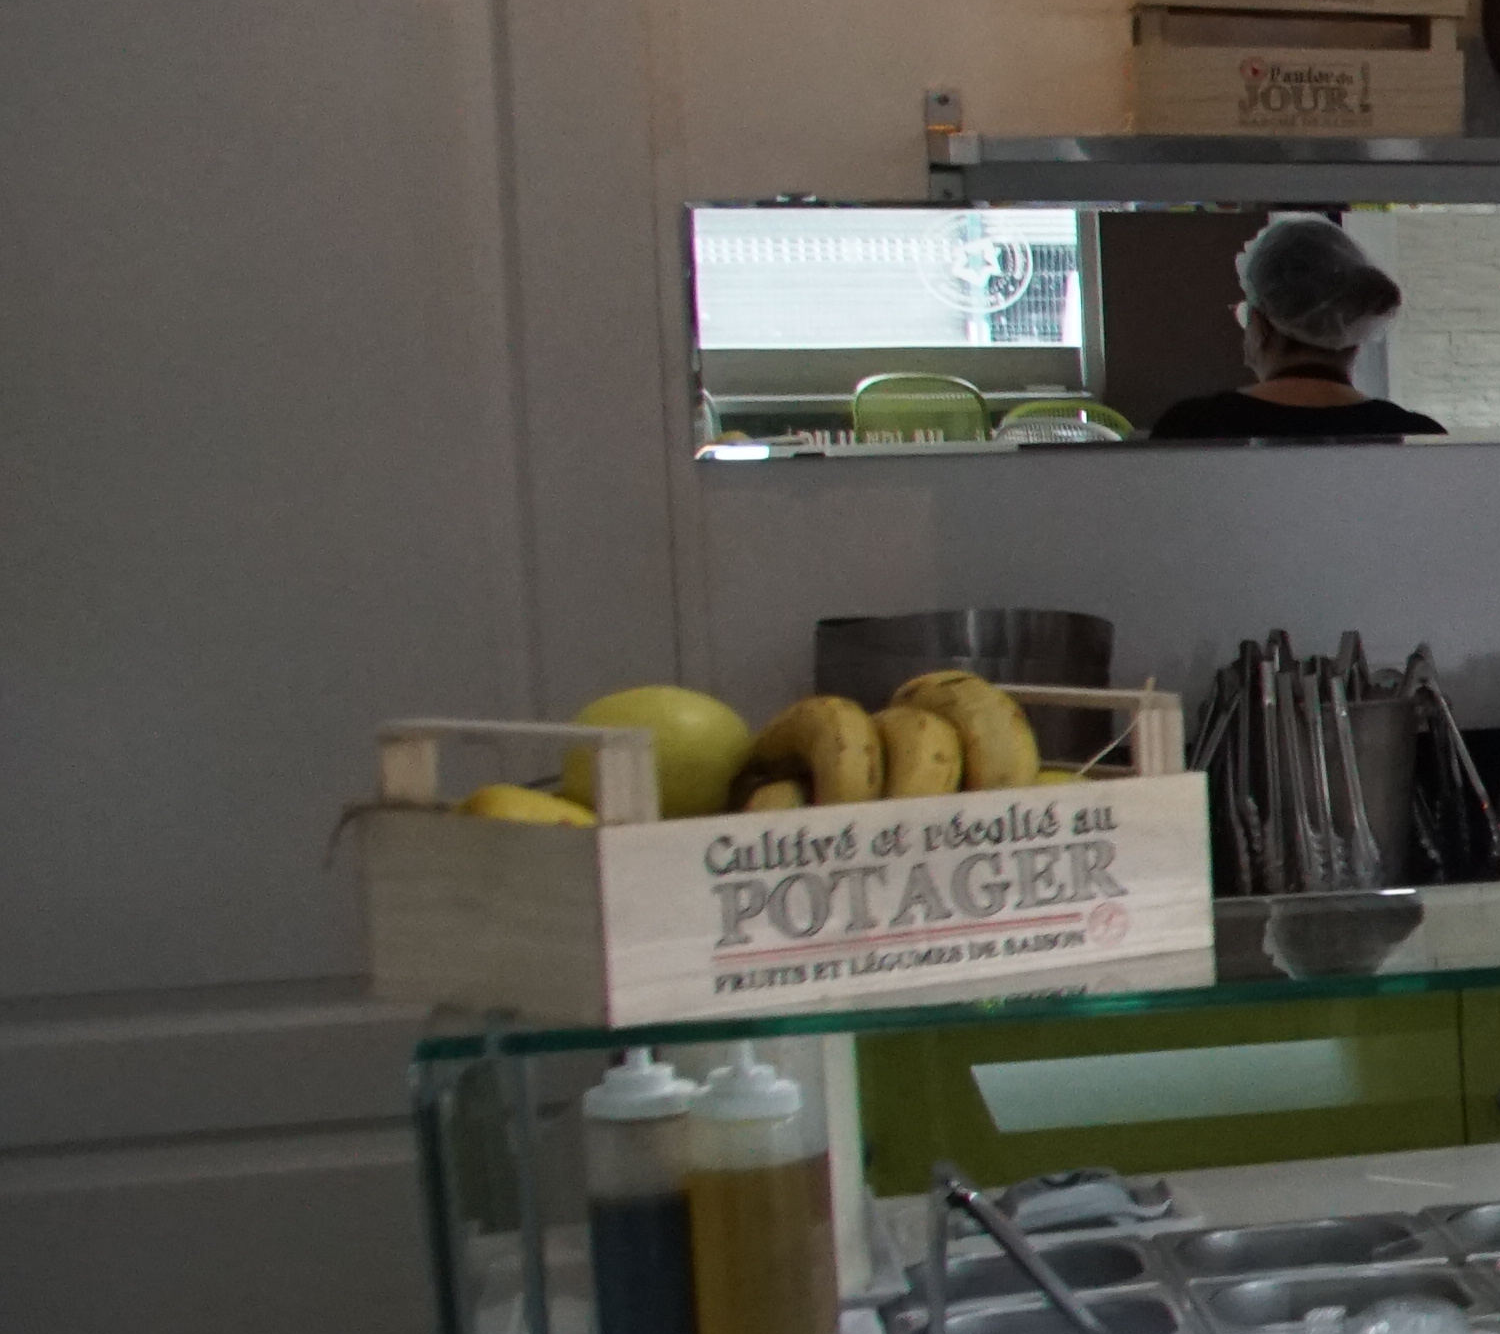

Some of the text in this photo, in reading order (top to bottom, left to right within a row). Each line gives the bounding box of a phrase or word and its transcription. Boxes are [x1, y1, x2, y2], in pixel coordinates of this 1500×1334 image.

[704, 800, 1119, 875] Cultivé et récolté au
[712, 840, 1129, 948] POTAGER
[713, 930, 1085, 994] FRUITS ET LÉGUMES DE SAISON
